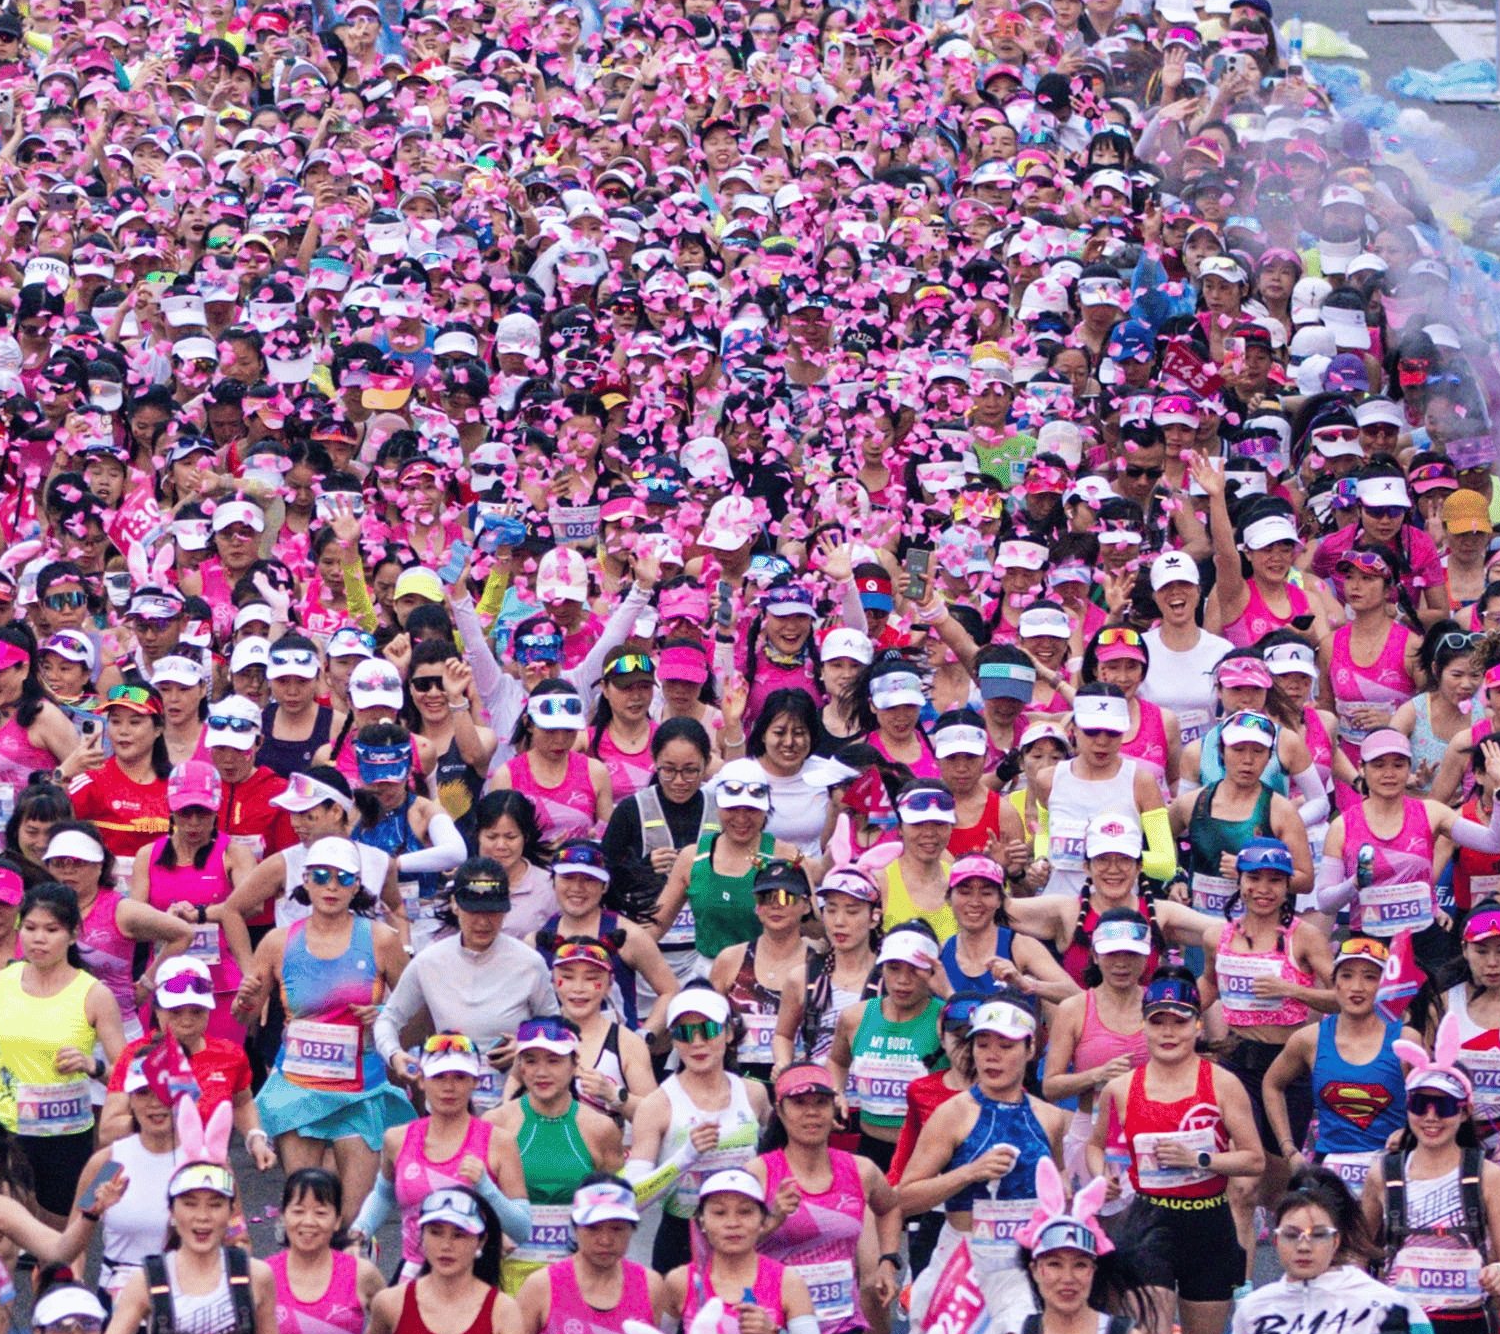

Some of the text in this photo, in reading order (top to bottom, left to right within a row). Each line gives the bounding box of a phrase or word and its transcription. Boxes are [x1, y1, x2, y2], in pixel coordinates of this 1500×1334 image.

[1382, 901, 1420, 919] 1256
[302, 1042, 342, 1059] 0357
[42, 1101, 79, 1117] 1001
[1420, 1269, 1464, 1287] 0038
[808, 1284, 841, 1302] 238
